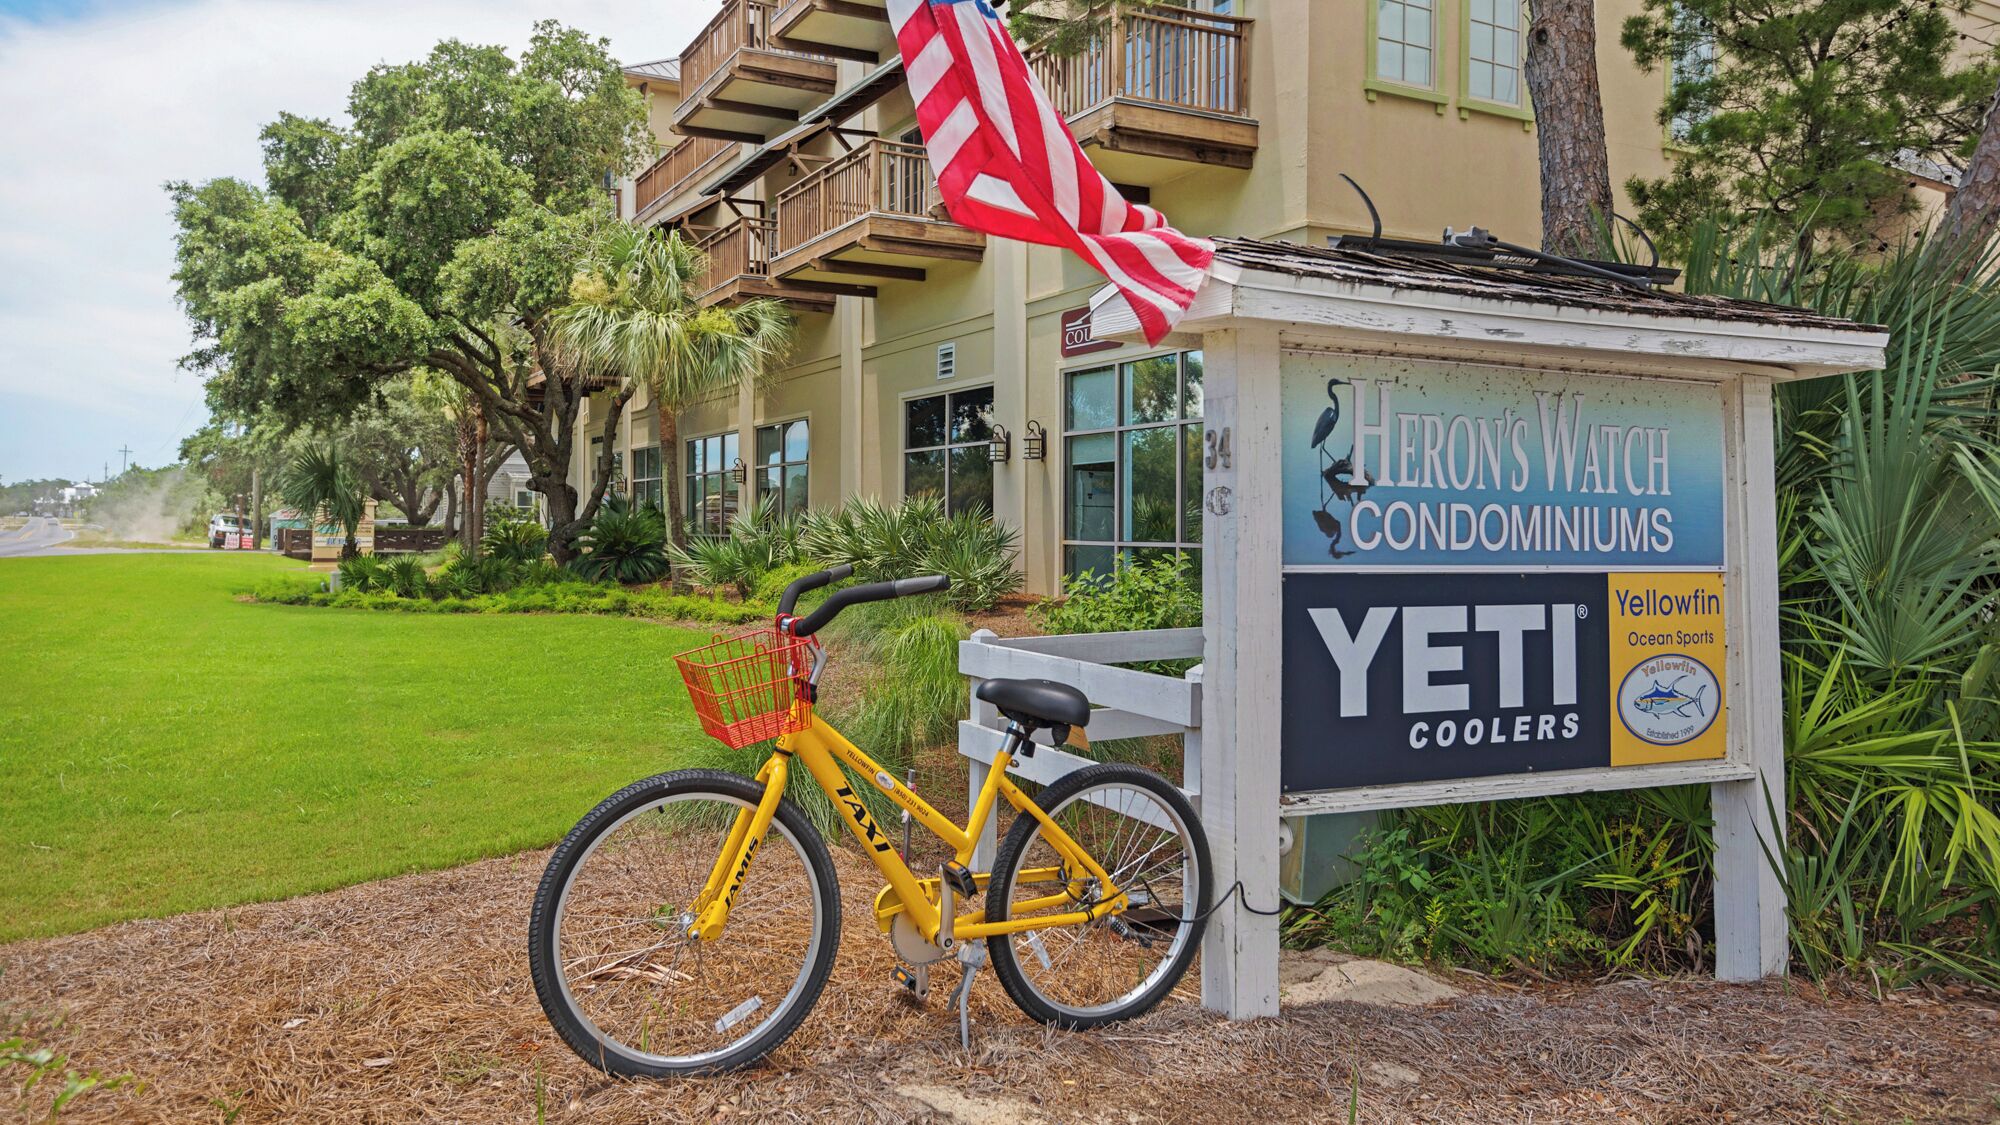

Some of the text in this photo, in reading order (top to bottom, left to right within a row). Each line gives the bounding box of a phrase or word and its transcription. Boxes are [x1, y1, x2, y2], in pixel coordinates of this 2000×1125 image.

[1205, 427, 1231, 470] 34
[1348, 377, 1672, 496] HERON'S WATCH
[1350, 501, 1673, 553] CONDOMINIUMS
[1615, 588, 1720, 617] Yellowfin
[1628, 630, 1714, 647] Ocean Sports
[1641, 659, 1697, 677] Yellowfin
[1409, 712, 1580, 749] COOLERS
[1646, 727, 1679, 739] Established
[846, 749, 876, 775] YELLOWFIN
[834, 781, 892, 853] TAXI
[726, 835, 759, 916] JAMIS
